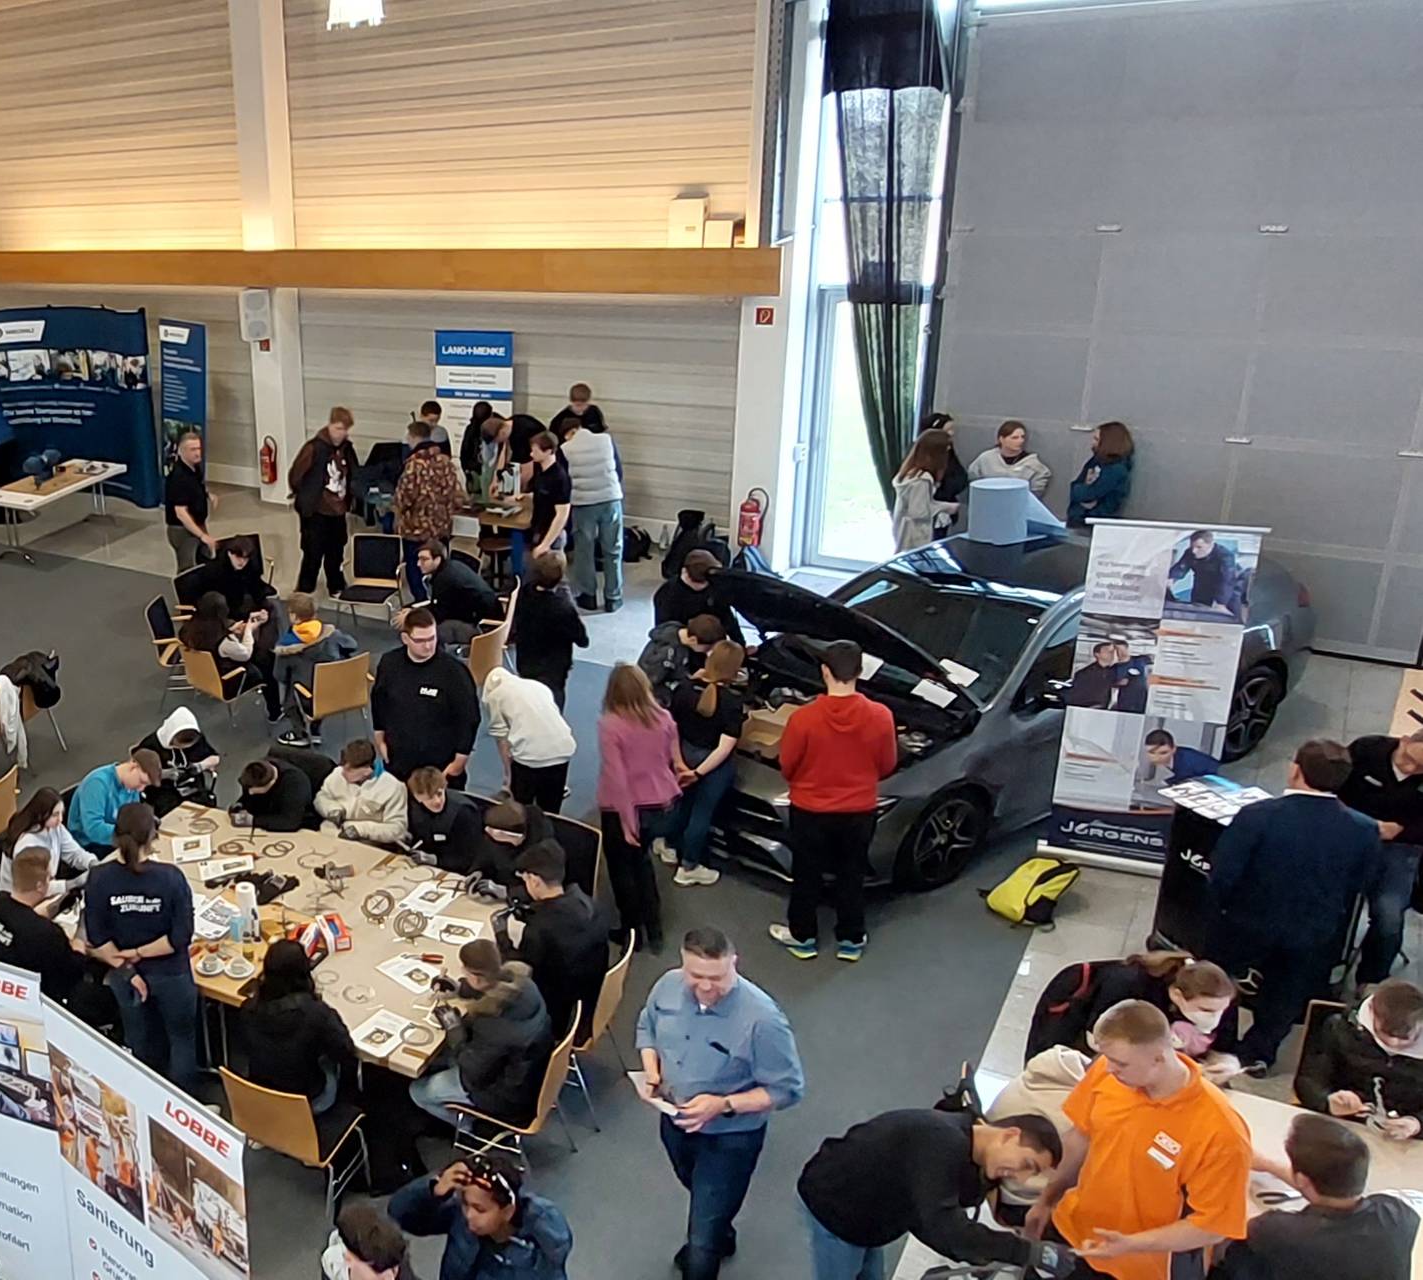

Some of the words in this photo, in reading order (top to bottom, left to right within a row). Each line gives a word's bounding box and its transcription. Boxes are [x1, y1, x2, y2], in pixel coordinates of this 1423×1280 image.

[441, 346, 506, 356] LANG+MENKE
[165, 1100, 231, 1159] LOBBE
[76, 1188, 155, 1269] Sanierung
